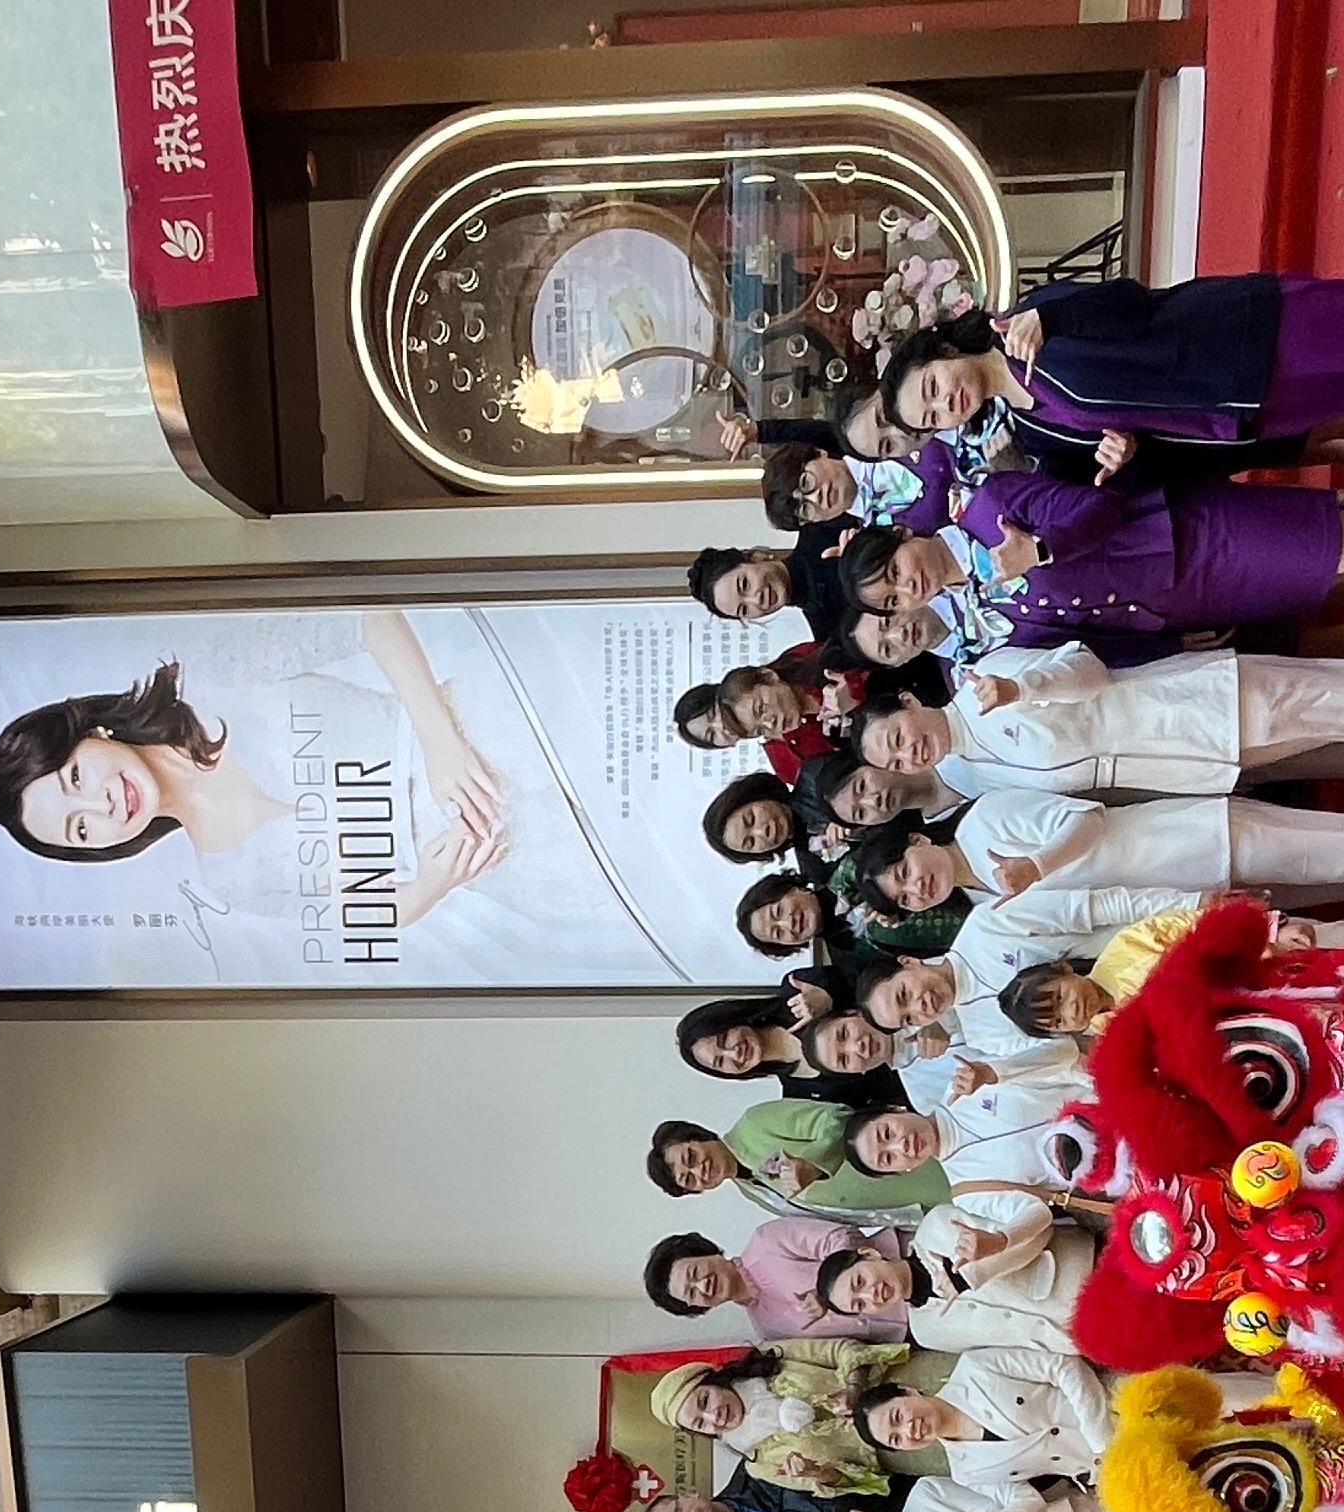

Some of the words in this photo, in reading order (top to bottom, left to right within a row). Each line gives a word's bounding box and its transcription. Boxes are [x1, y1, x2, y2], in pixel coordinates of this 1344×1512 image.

[145, 0, 206, 174] 热烈庆
[289, 702, 333, 964] PRESIDENT
[335, 759, 400, 964] HONOUR
